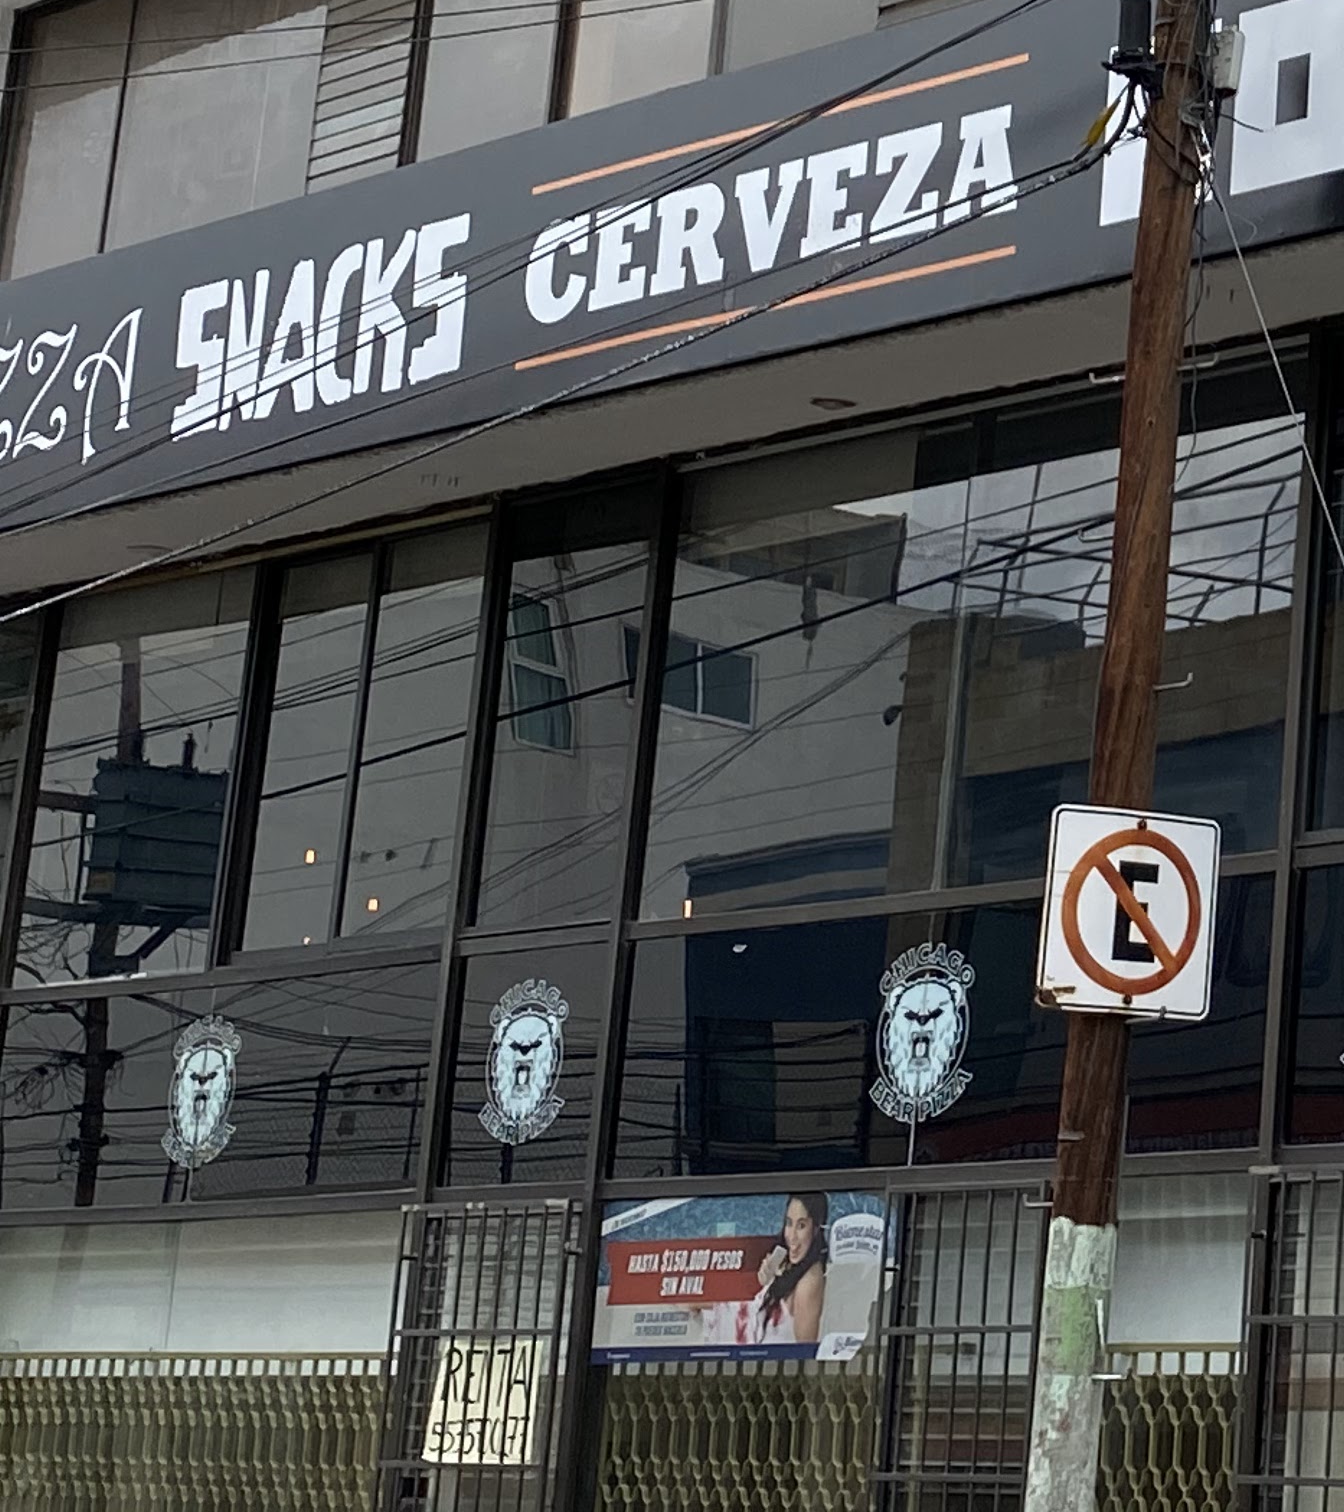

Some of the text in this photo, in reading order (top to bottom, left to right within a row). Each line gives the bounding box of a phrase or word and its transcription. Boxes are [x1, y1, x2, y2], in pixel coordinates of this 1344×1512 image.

[523, 105, 1017, 324] CERVEZA
[171, 211, 470, 442] SNACKS
[1111, 860, 1159, 963] E
[879, 943, 975, 996] CHICAGO
[869, 1077, 915, 1124] BEAR
[627, 1254, 659, 1273] HASTA
[710, 1250, 744, 1271] PESOS
[679, 1276, 704, 1295] AVAL
